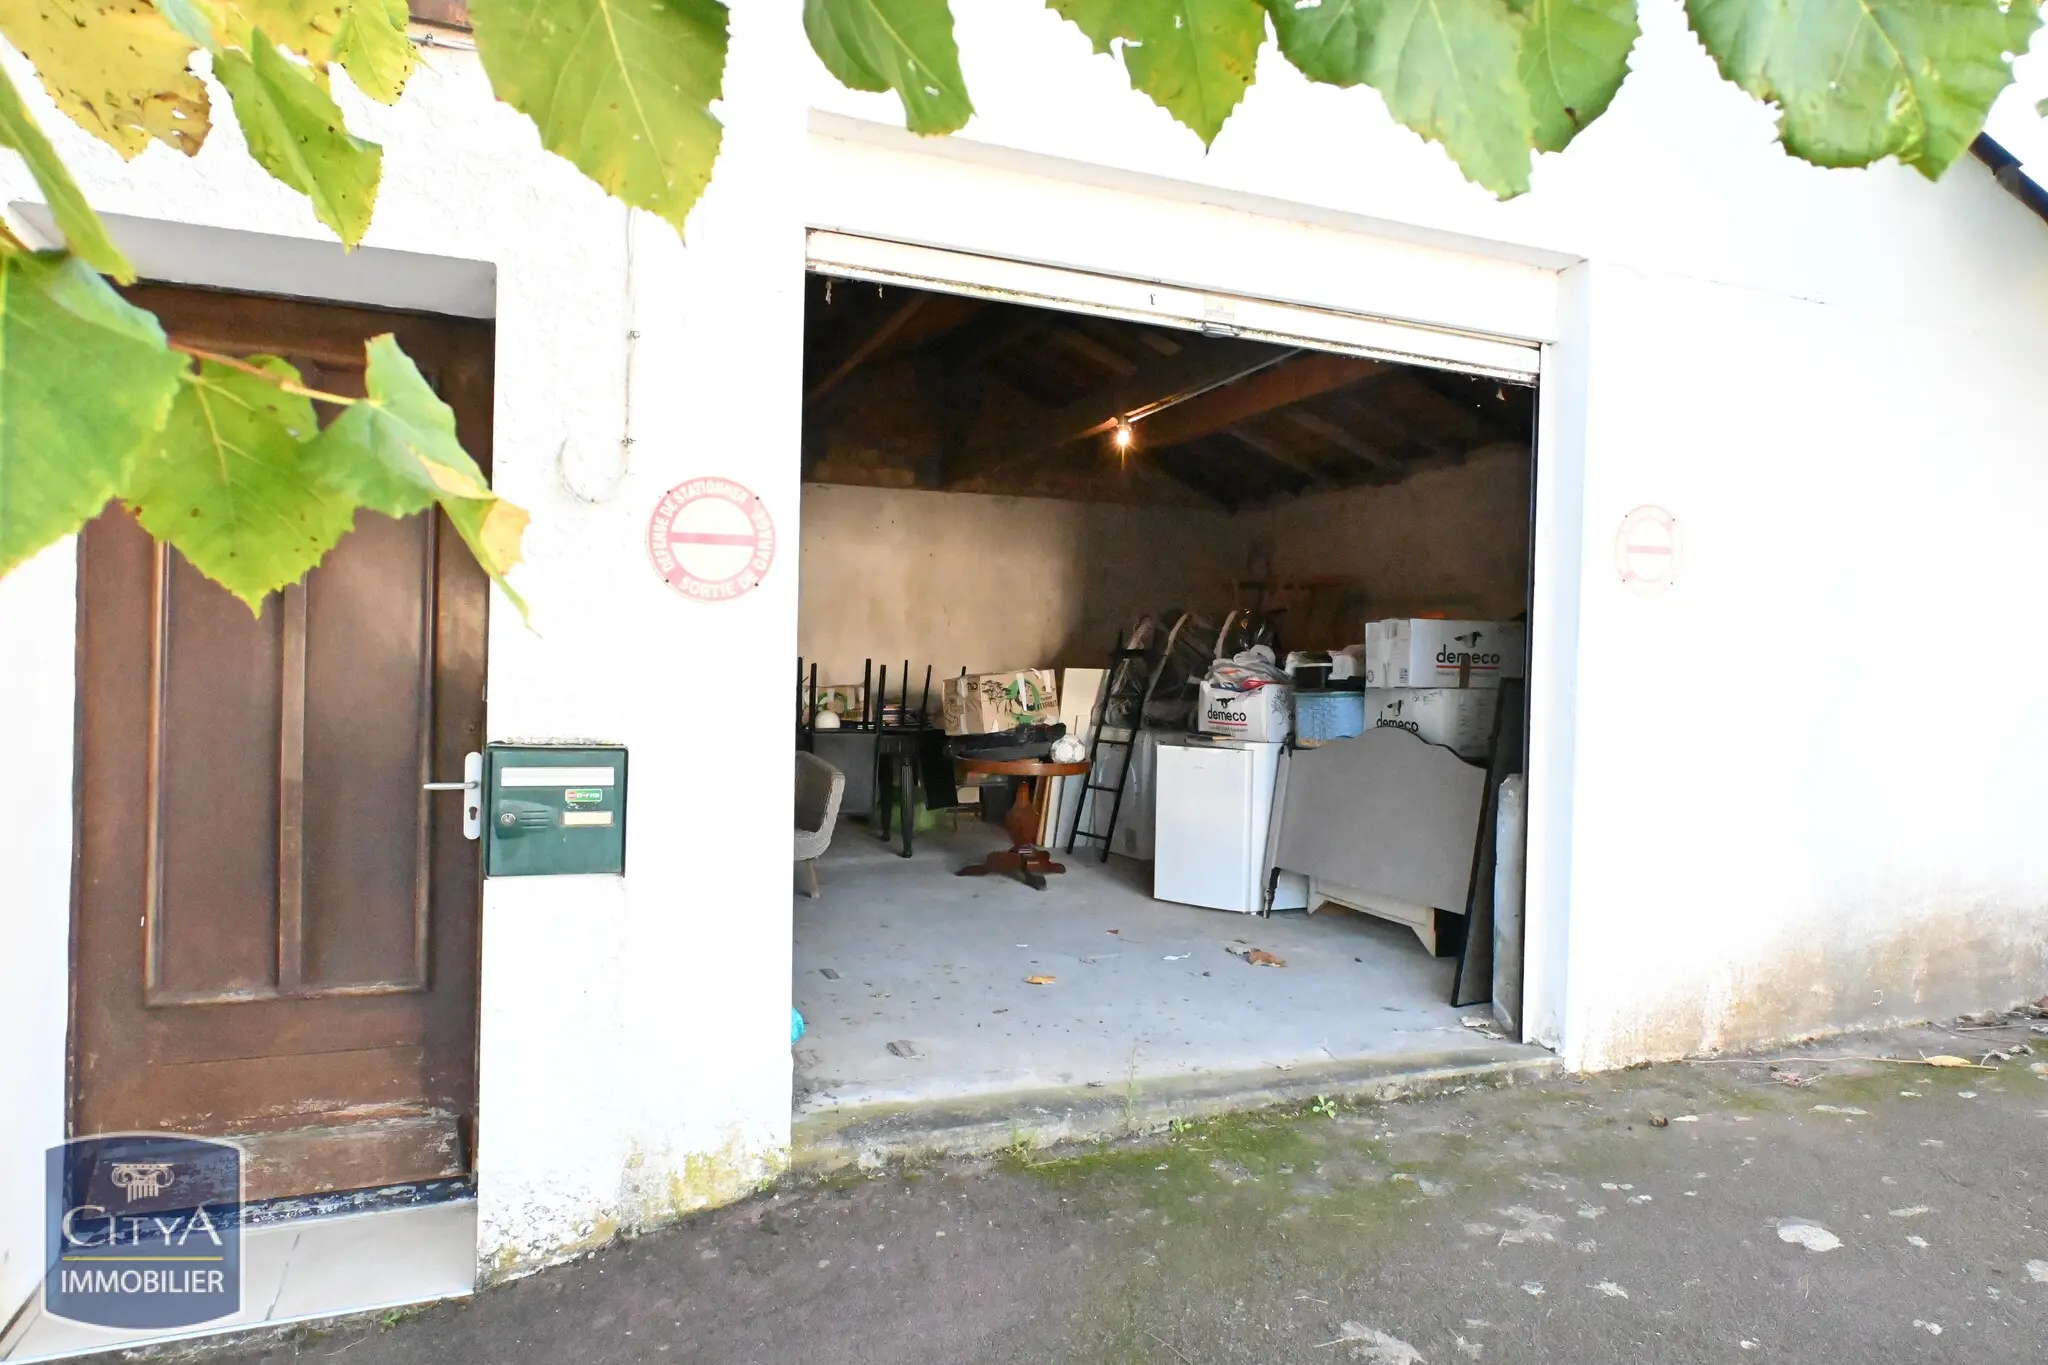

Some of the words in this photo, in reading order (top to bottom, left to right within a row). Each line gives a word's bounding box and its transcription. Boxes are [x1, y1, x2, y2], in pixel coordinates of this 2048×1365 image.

[680, 576, 737, 598] SORTIE
[1436, 643, 1500, 664] demeco
[1207, 703, 1247, 722] demeco
